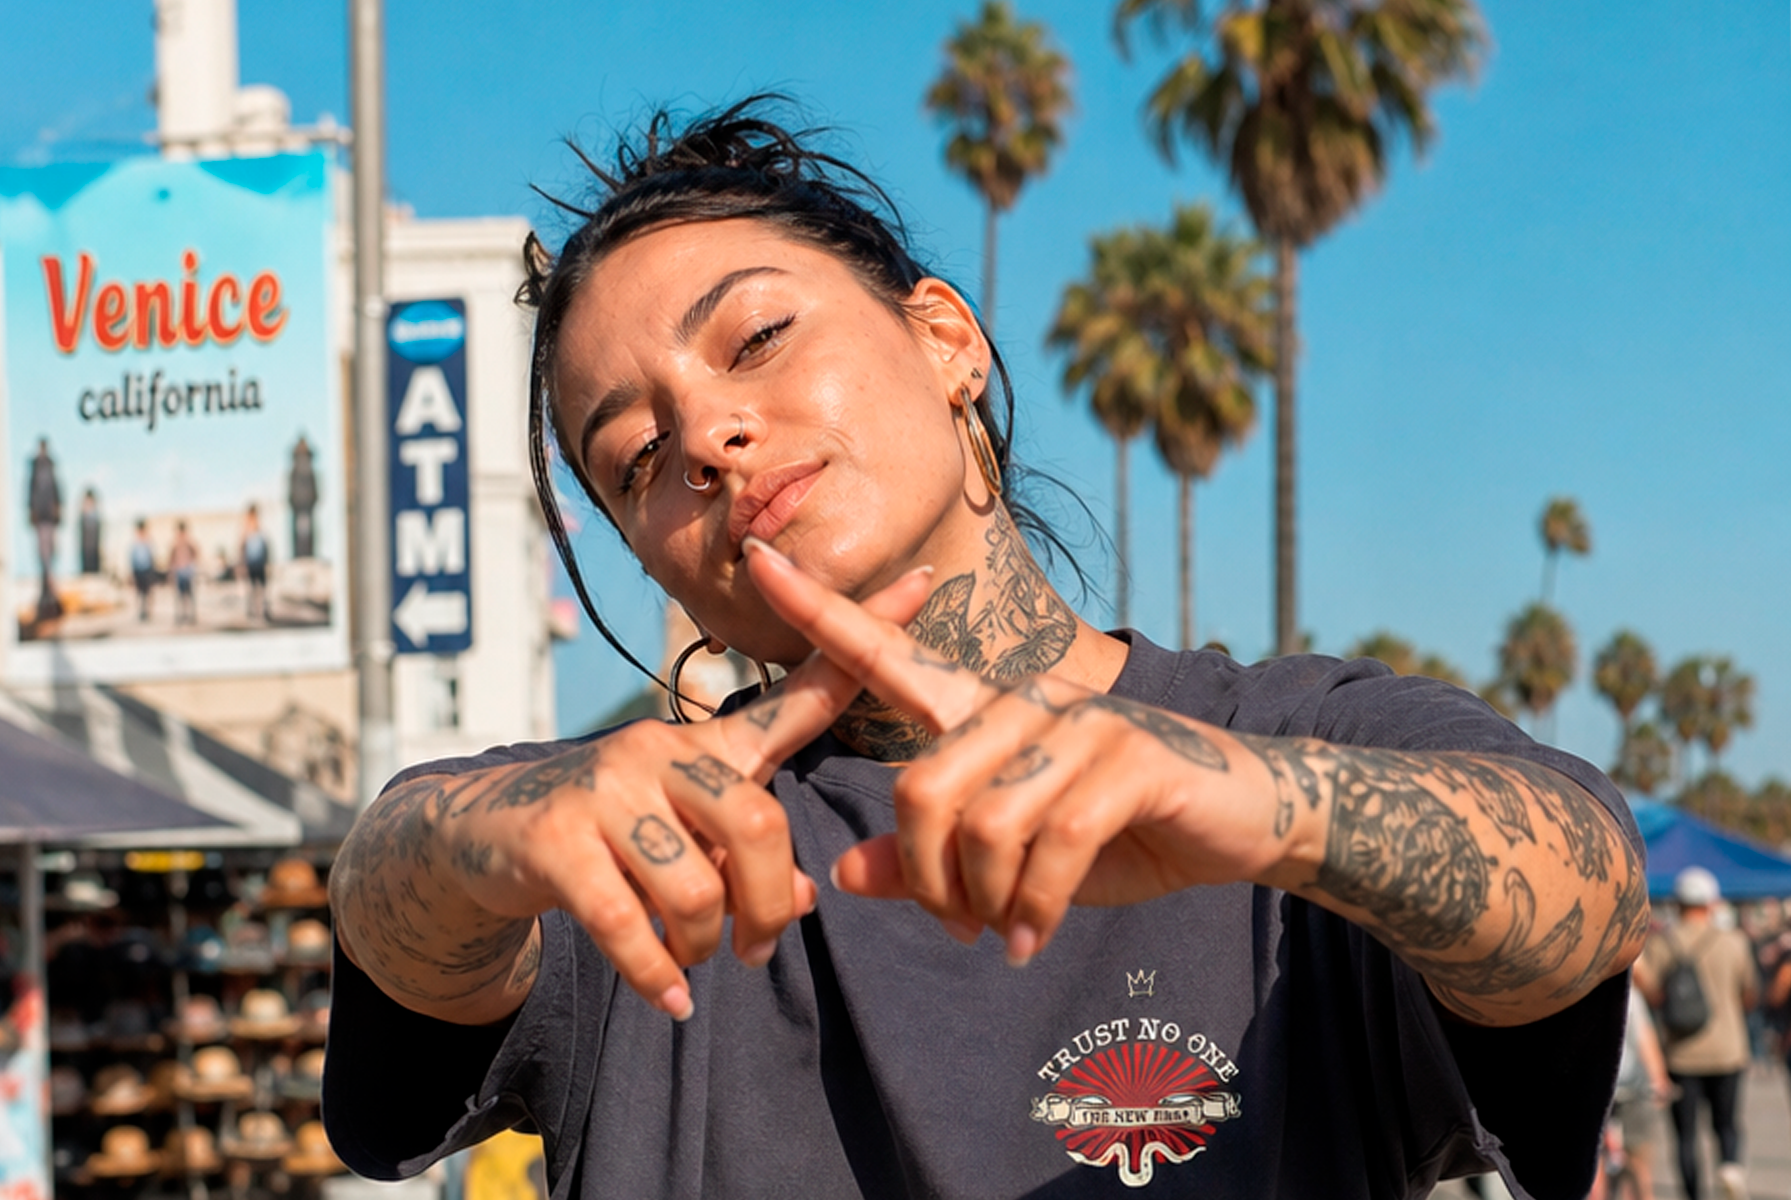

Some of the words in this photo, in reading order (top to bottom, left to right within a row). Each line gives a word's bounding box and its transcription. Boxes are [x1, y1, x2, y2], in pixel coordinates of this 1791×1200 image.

[41, 249, 288, 353] Venice
[78, 369, 262, 431] california
[396, 366, 464, 576] ATM
[1037, 1018, 1130, 1082] TRUST
[1137, 1018, 1181, 1042] NO
[1187, 1033, 1239, 1083] ONE
[1114, 1109, 1148, 1123] NEW
